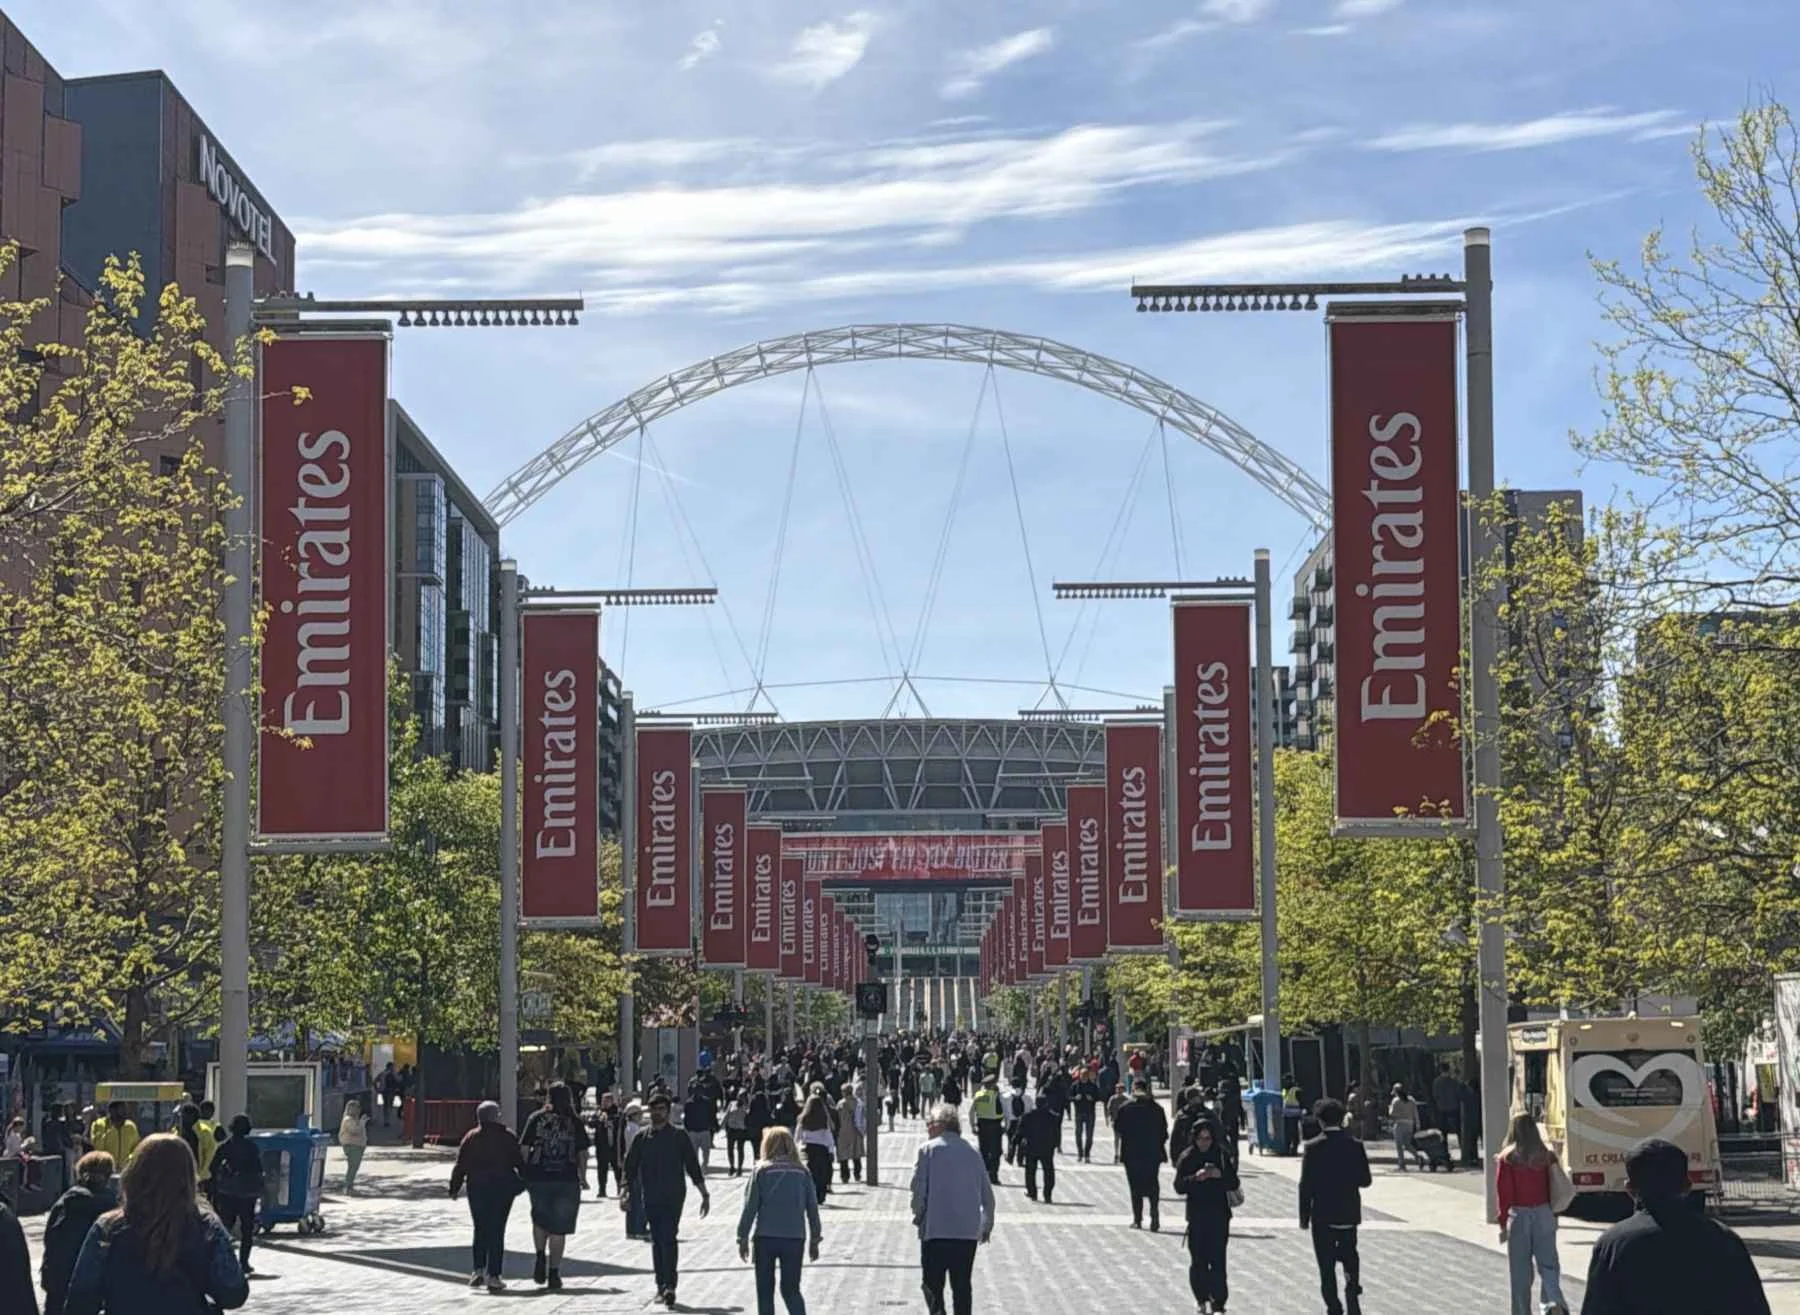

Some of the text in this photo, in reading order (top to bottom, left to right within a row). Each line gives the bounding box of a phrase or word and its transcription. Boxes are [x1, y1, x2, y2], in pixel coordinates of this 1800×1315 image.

[200, 134, 277, 267] NOVOTEL
[281, 429, 351, 735] Emirates
[1355, 412, 1425, 723] Emirates
[534, 668, 577, 859] Emirates
[1190, 661, 1232, 852] Emirates
[645, 769, 676, 908] Emirates
[709, 822, 734, 931] Emirates
[752, 853, 771, 943] Emirates
[1049, 850, 1069, 939] Emirates
[1076, 817, 1100, 926] Emirates
[1116, 766, 1148, 904] Emirates
